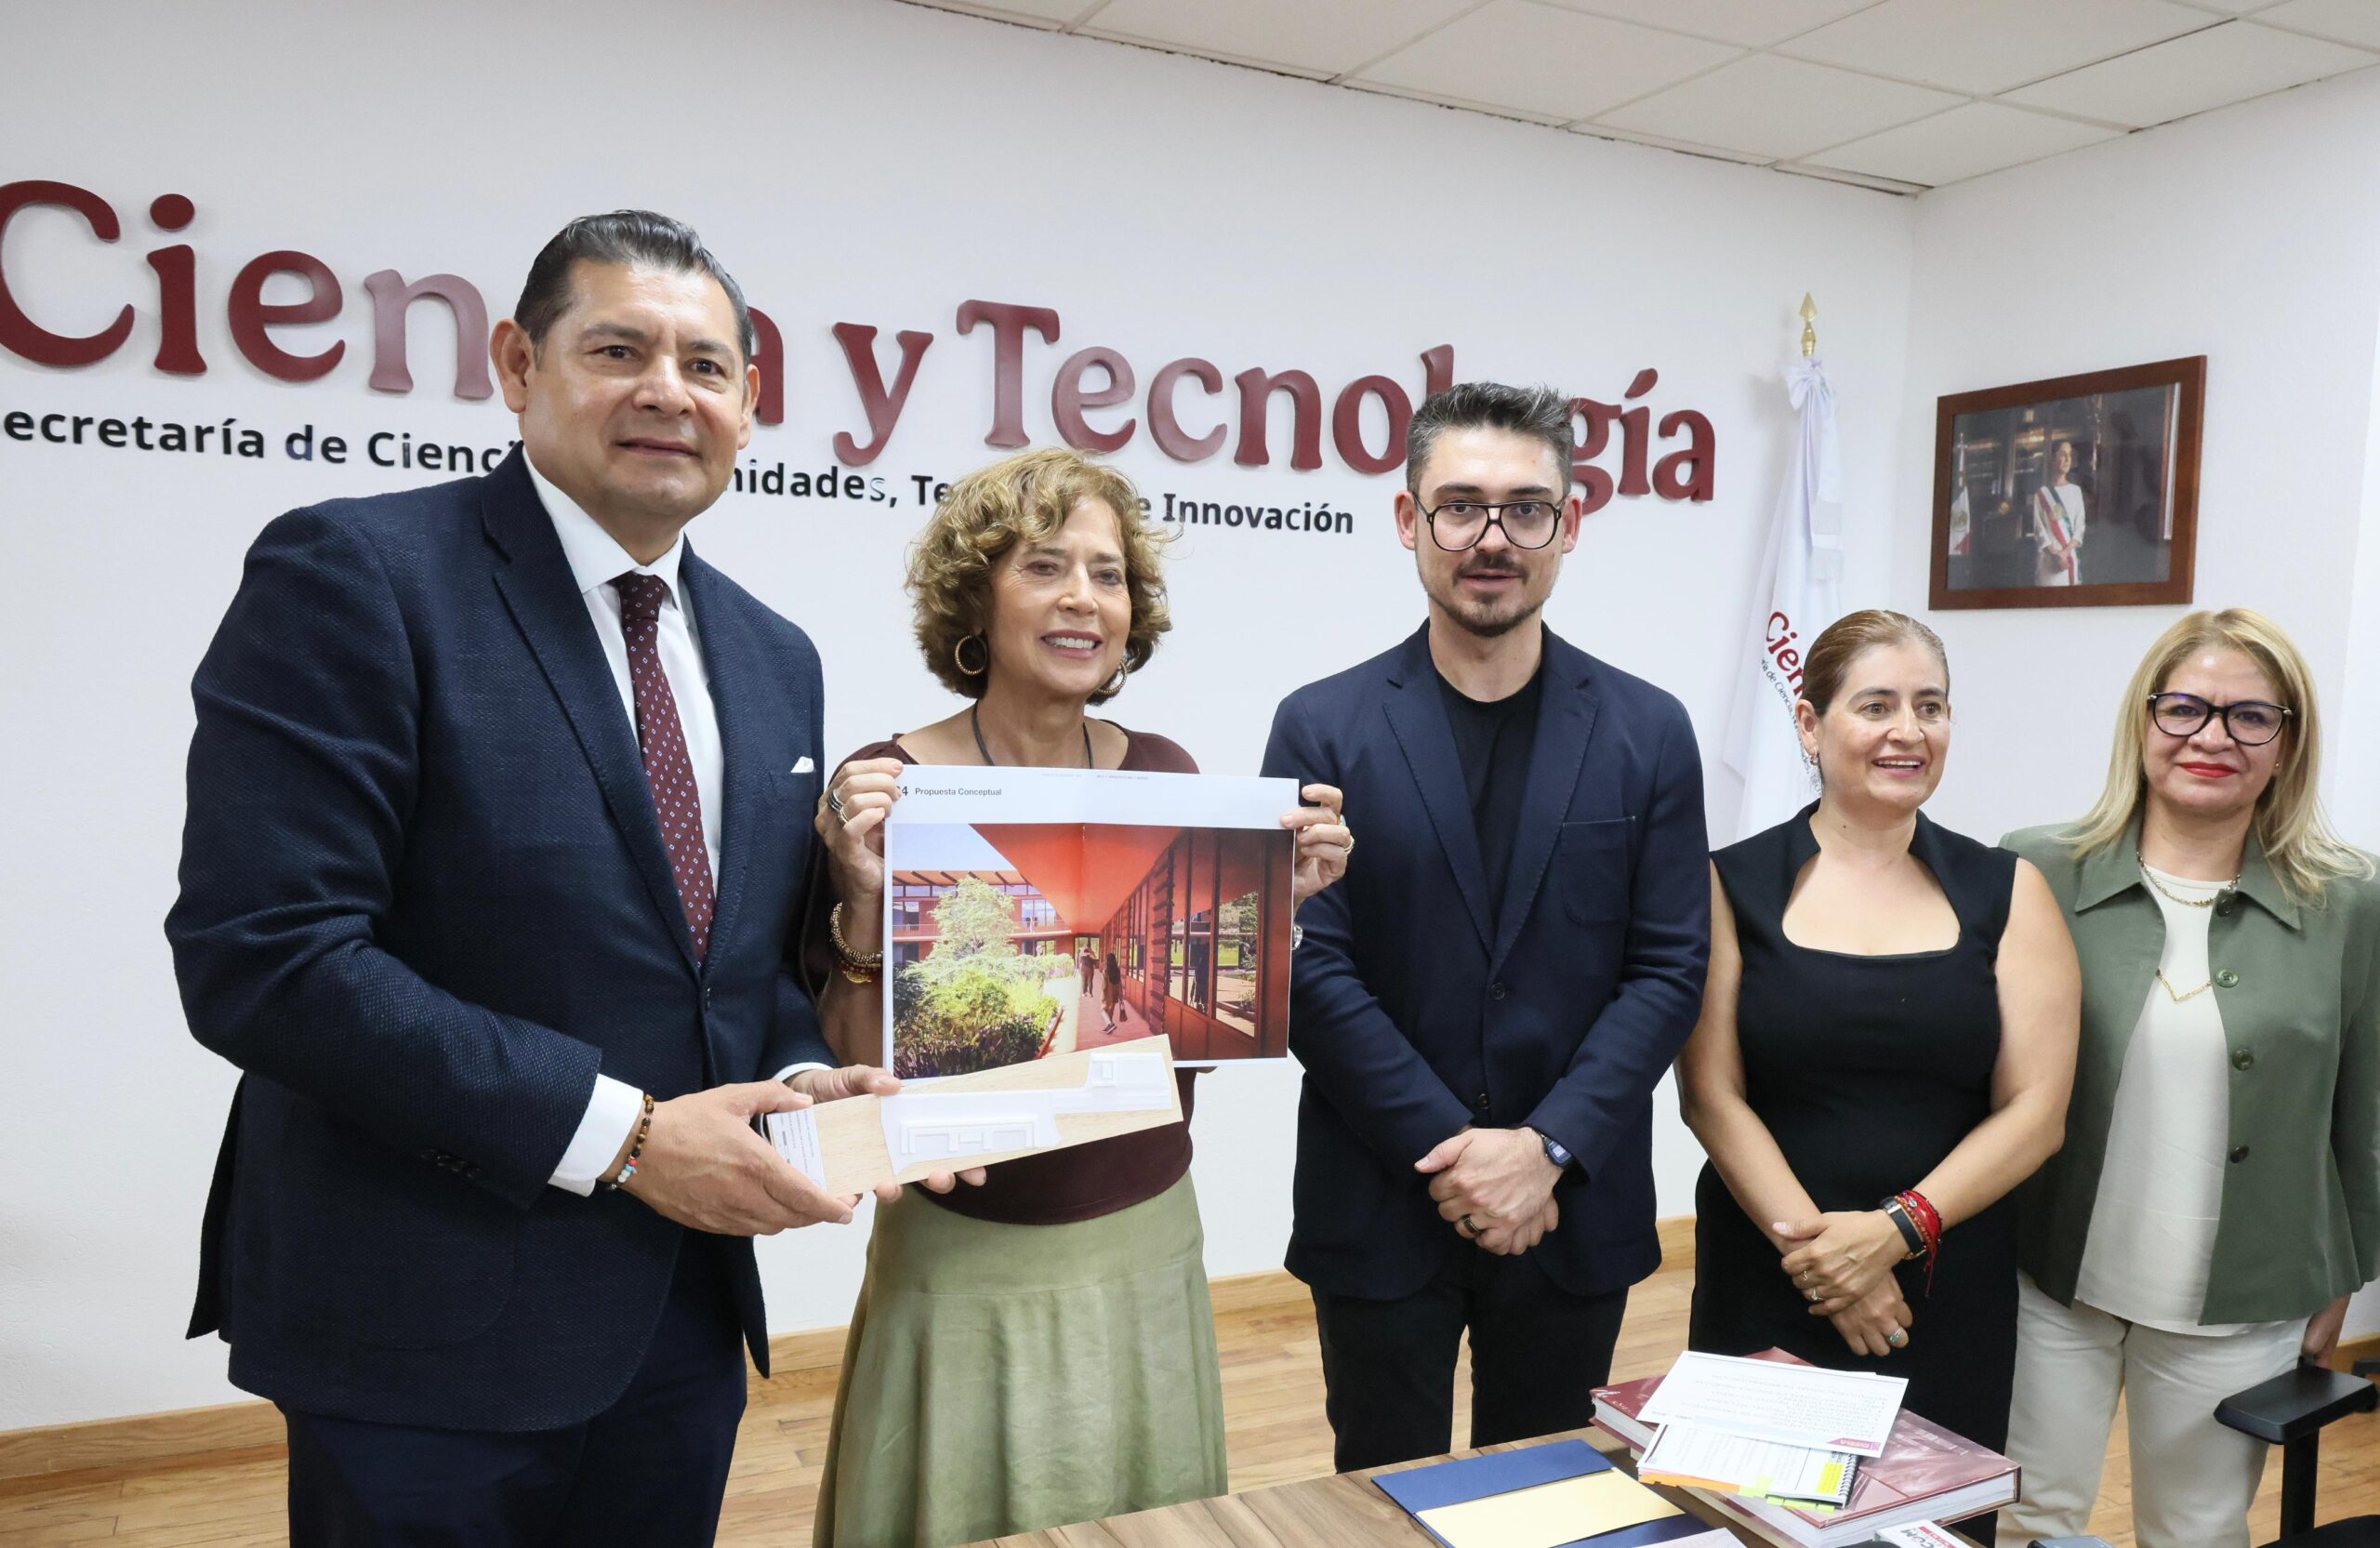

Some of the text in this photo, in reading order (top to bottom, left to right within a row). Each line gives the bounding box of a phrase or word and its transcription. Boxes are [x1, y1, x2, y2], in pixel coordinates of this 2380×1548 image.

[832, 322, 934, 466] y
[956, 298, 1716, 518] Tecnogía
[3, 410, 265, 458] ecretaría
[284, 424, 348, 463] de
[367, 432, 516, 472] Cienc
[733, 459, 897, 508] idades,
[1162, 493, 1354, 534] Innovación
[1766, 612, 1805, 695] Cien
[915, 787, 956, 797] Propuesta
[958, 787, 1002, 797] Conceptual
